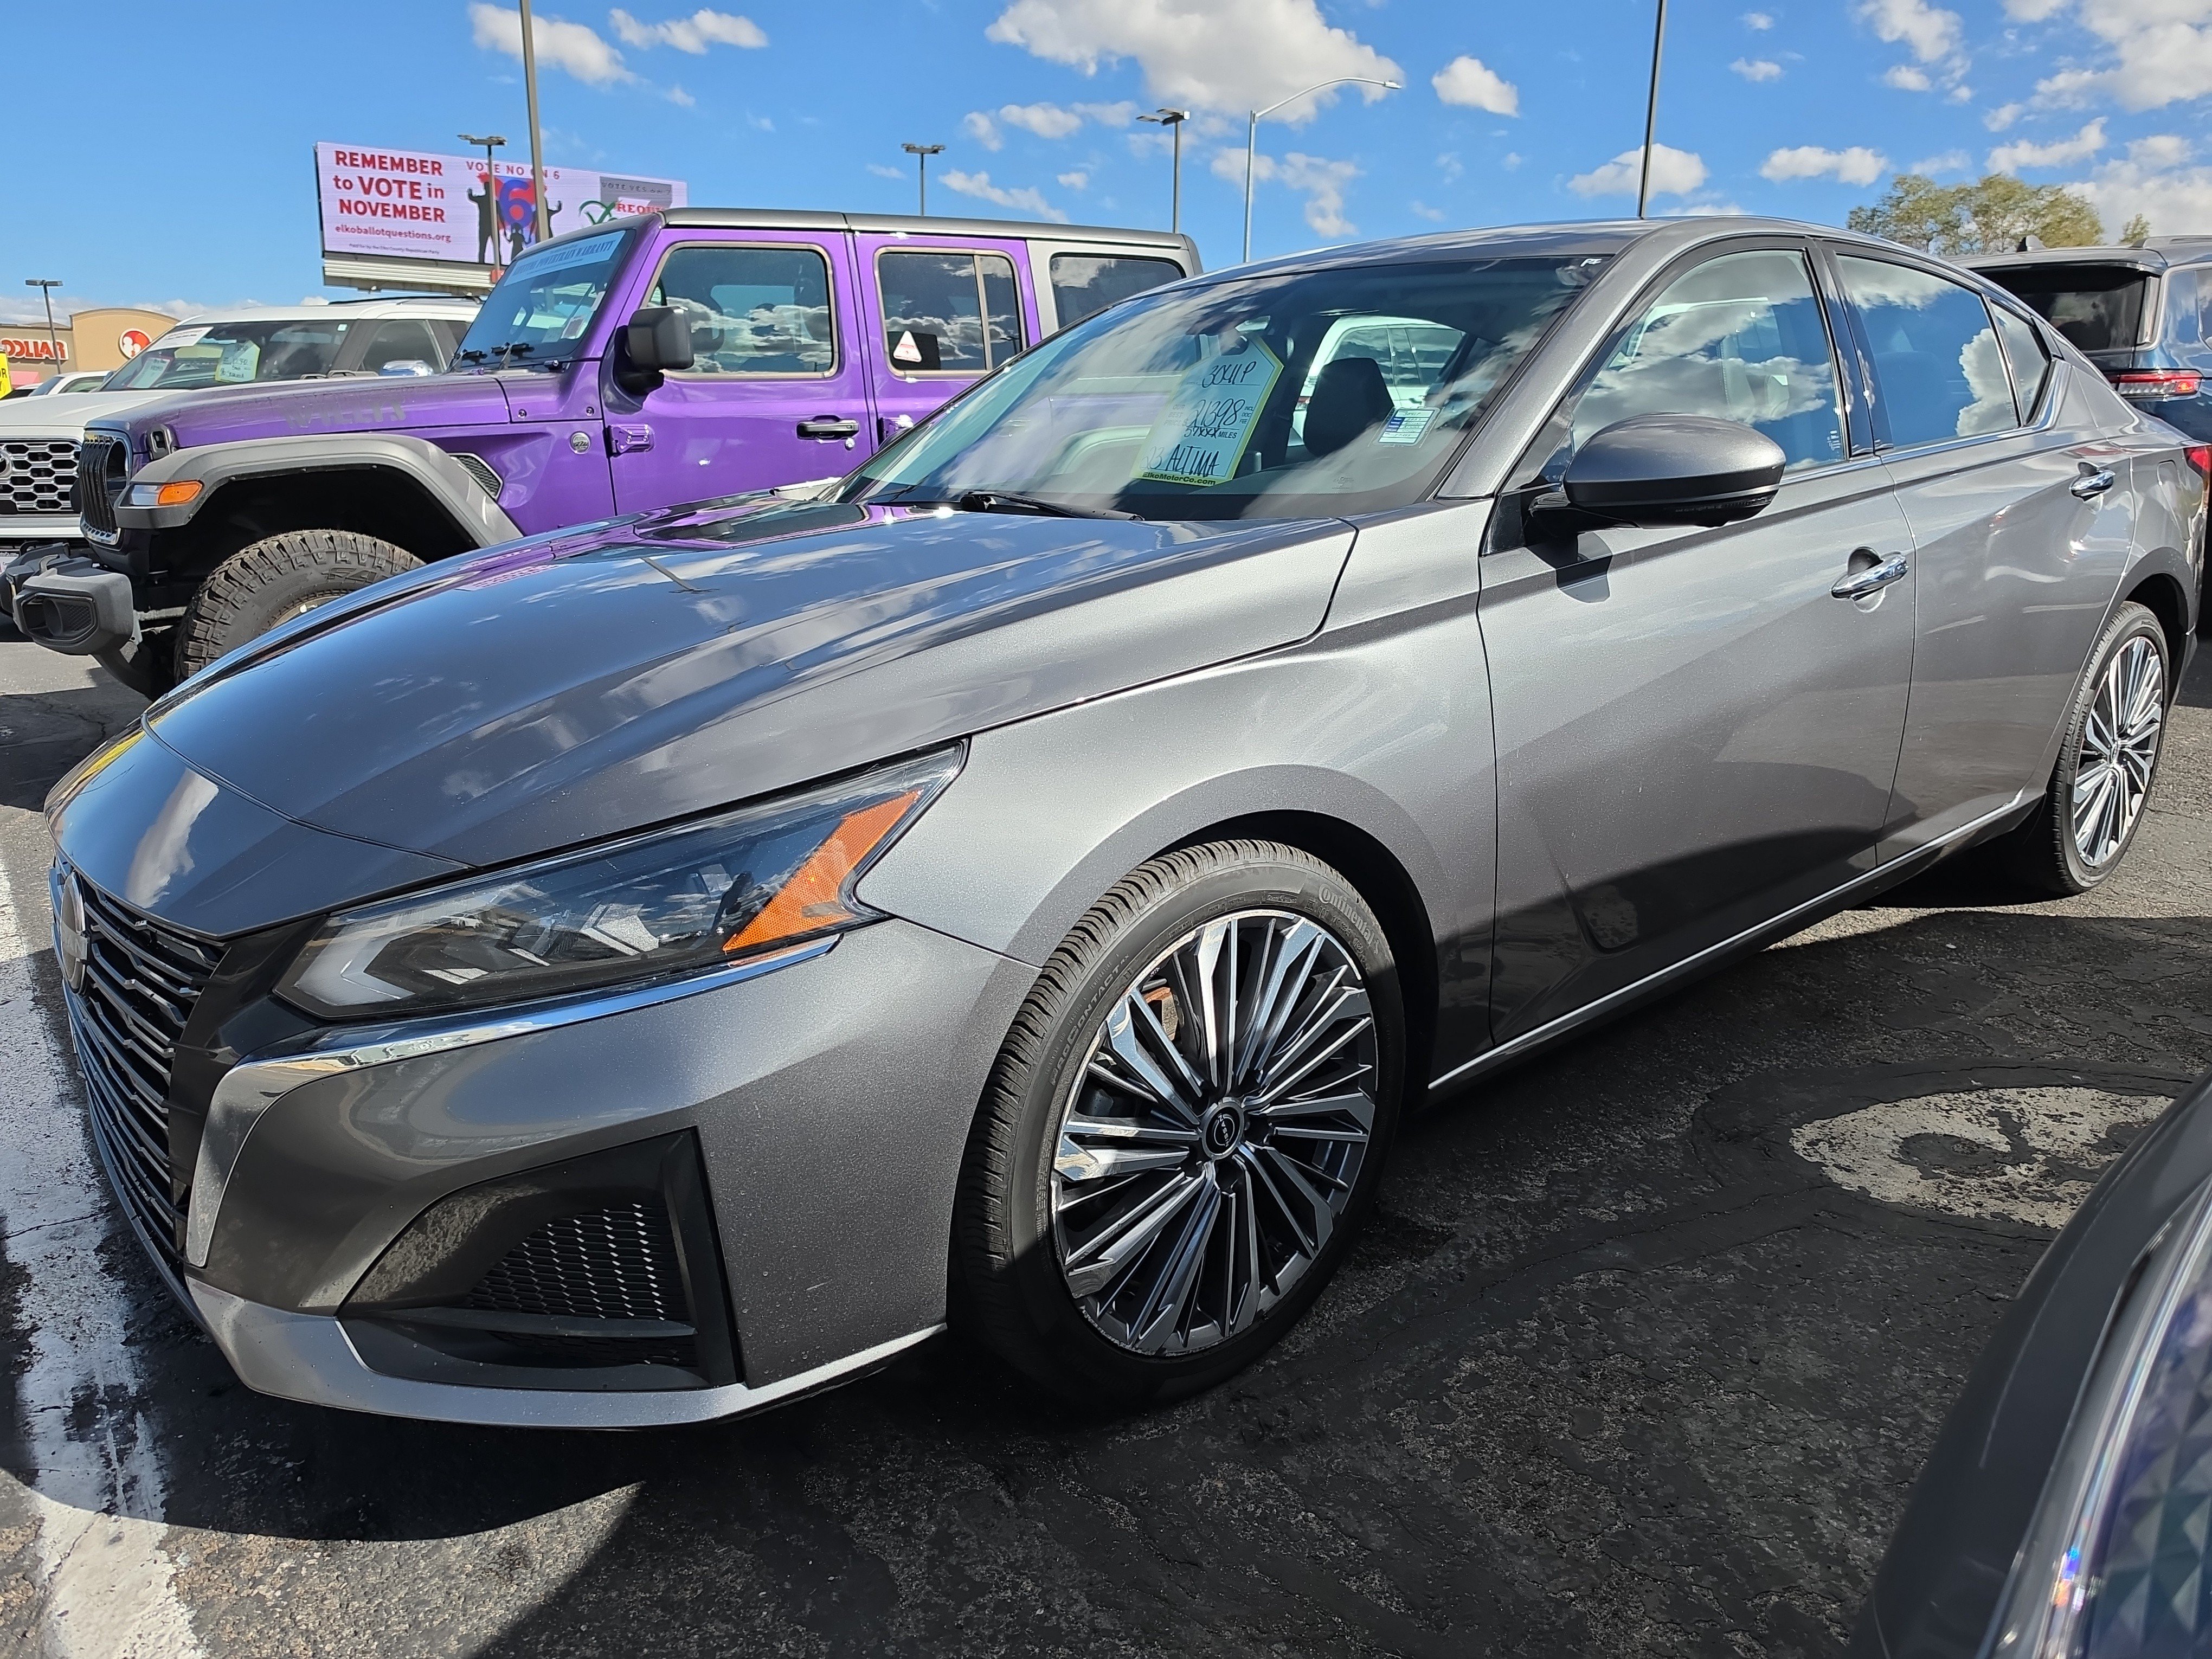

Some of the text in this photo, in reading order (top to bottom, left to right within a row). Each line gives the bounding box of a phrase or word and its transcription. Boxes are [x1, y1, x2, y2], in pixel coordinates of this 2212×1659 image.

[335, 150, 443, 177] REMEMBER
[466, 161, 500, 173] VOE
[506, 165, 524, 176] NO
[554, 171, 560, 179] 6
[333, 175, 444, 200] to VOTE in
[601, 182, 626, 191] VOTE
[339, 199, 445, 223] NOVEMBER
[335, 225, 452, 243] elkoballotquestions.org
[1218, 431, 1238, 439] MILES
[1165, 443, 1220, 477] ALTIMA
[1142, 472, 1216, 485] ElkoMotorCo.com
[1319, 884, 1374, 946] Continental
[1218, 1114, 1229, 1147] NISSAN
